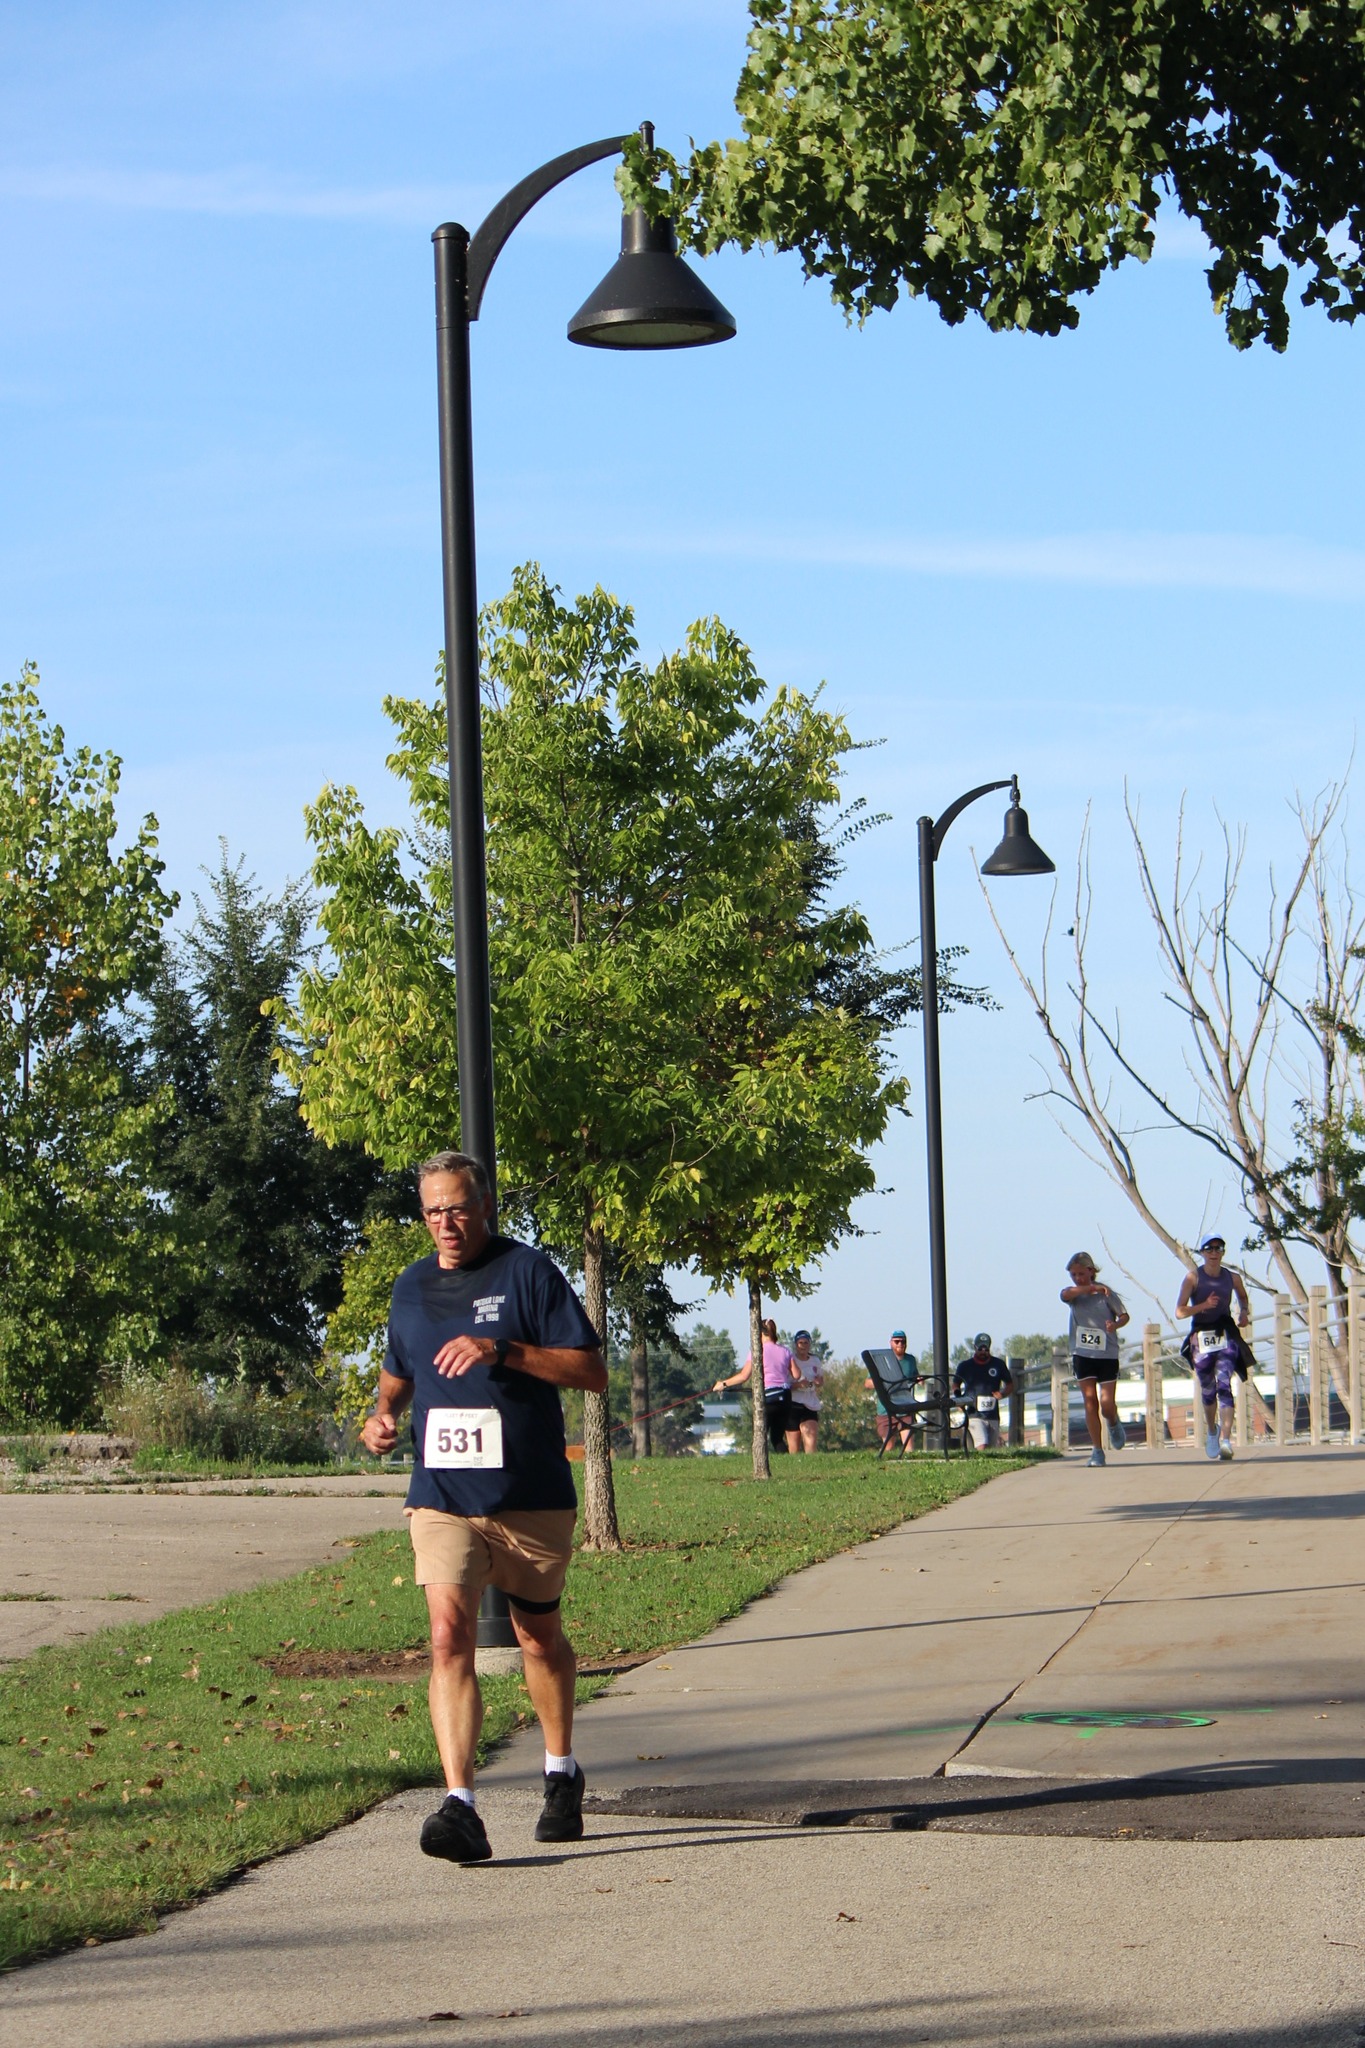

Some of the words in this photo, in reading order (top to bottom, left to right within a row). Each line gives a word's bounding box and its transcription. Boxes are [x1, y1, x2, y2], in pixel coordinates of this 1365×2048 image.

[492, 1295, 506, 1304] LAKE
[1081, 1333, 1101, 1345] 524
[1204, 1335, 1221, 1347] 647
[437, 1427, 483, 1454] 531
